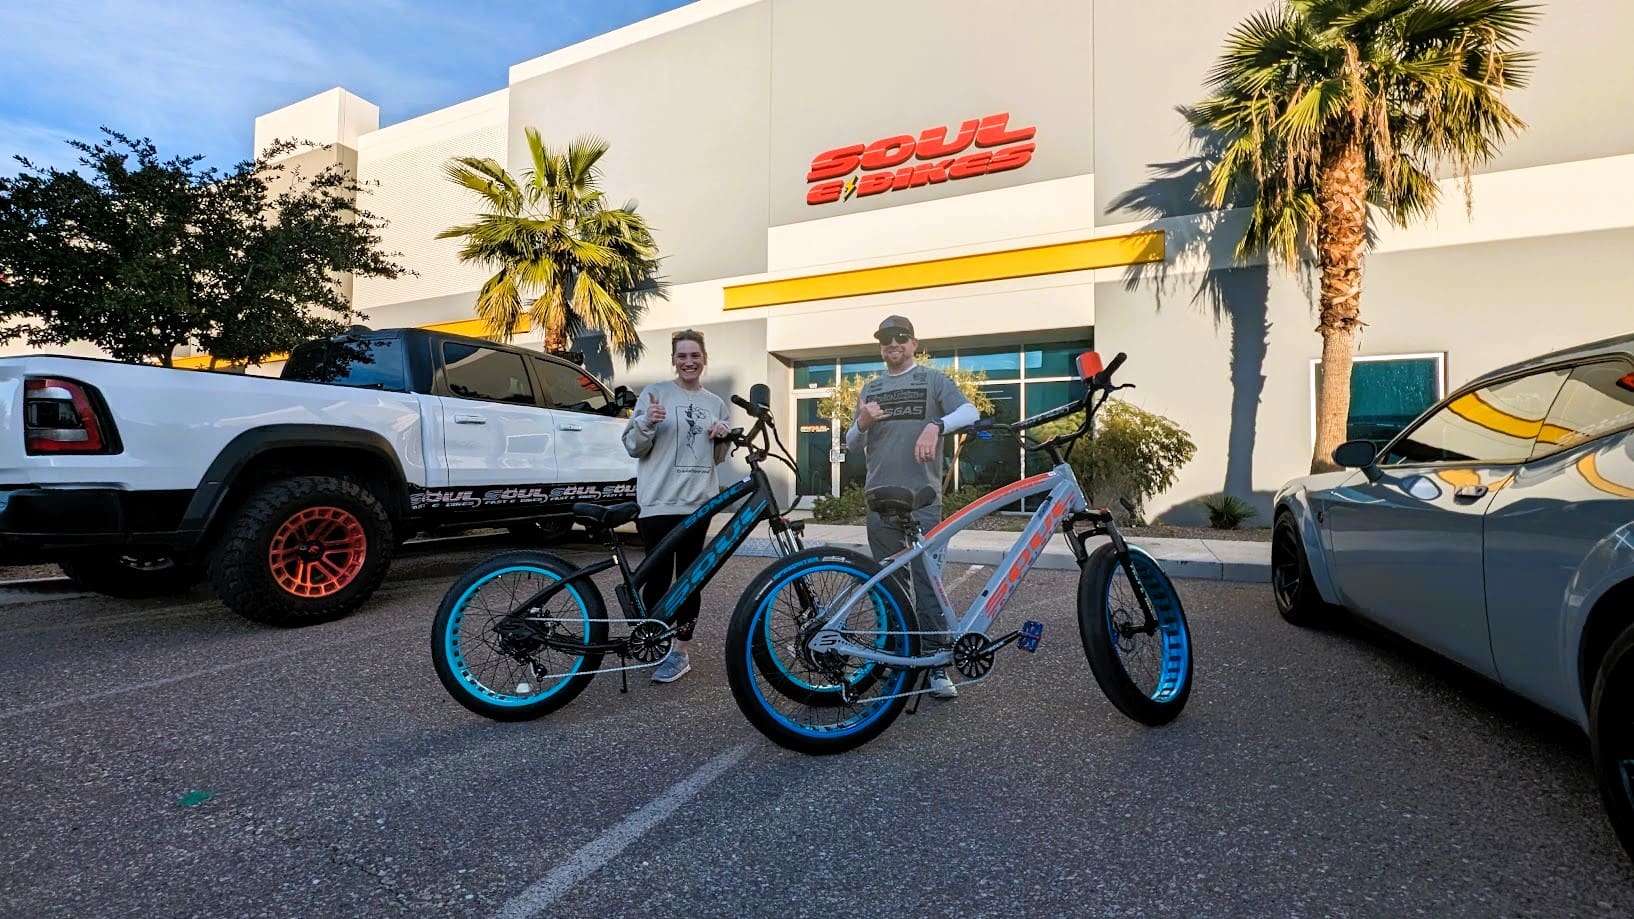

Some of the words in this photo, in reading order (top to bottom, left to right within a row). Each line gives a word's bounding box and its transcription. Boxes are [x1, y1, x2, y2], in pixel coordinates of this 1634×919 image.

[806, 180, 844, 205] E
[856, 142, 1036, 198] BIKES
[807, 112, 1036, 183] SOUL
[884, 406, 924, 416] SGAS
[483, 488, 548, 503] SOUL
[549, 485, 601, 499] SOUL
[602, 484, 637, 495] SOU
[662, 500, 768, 618] SOUL
[985, 491, 1075, 619] SOUL
